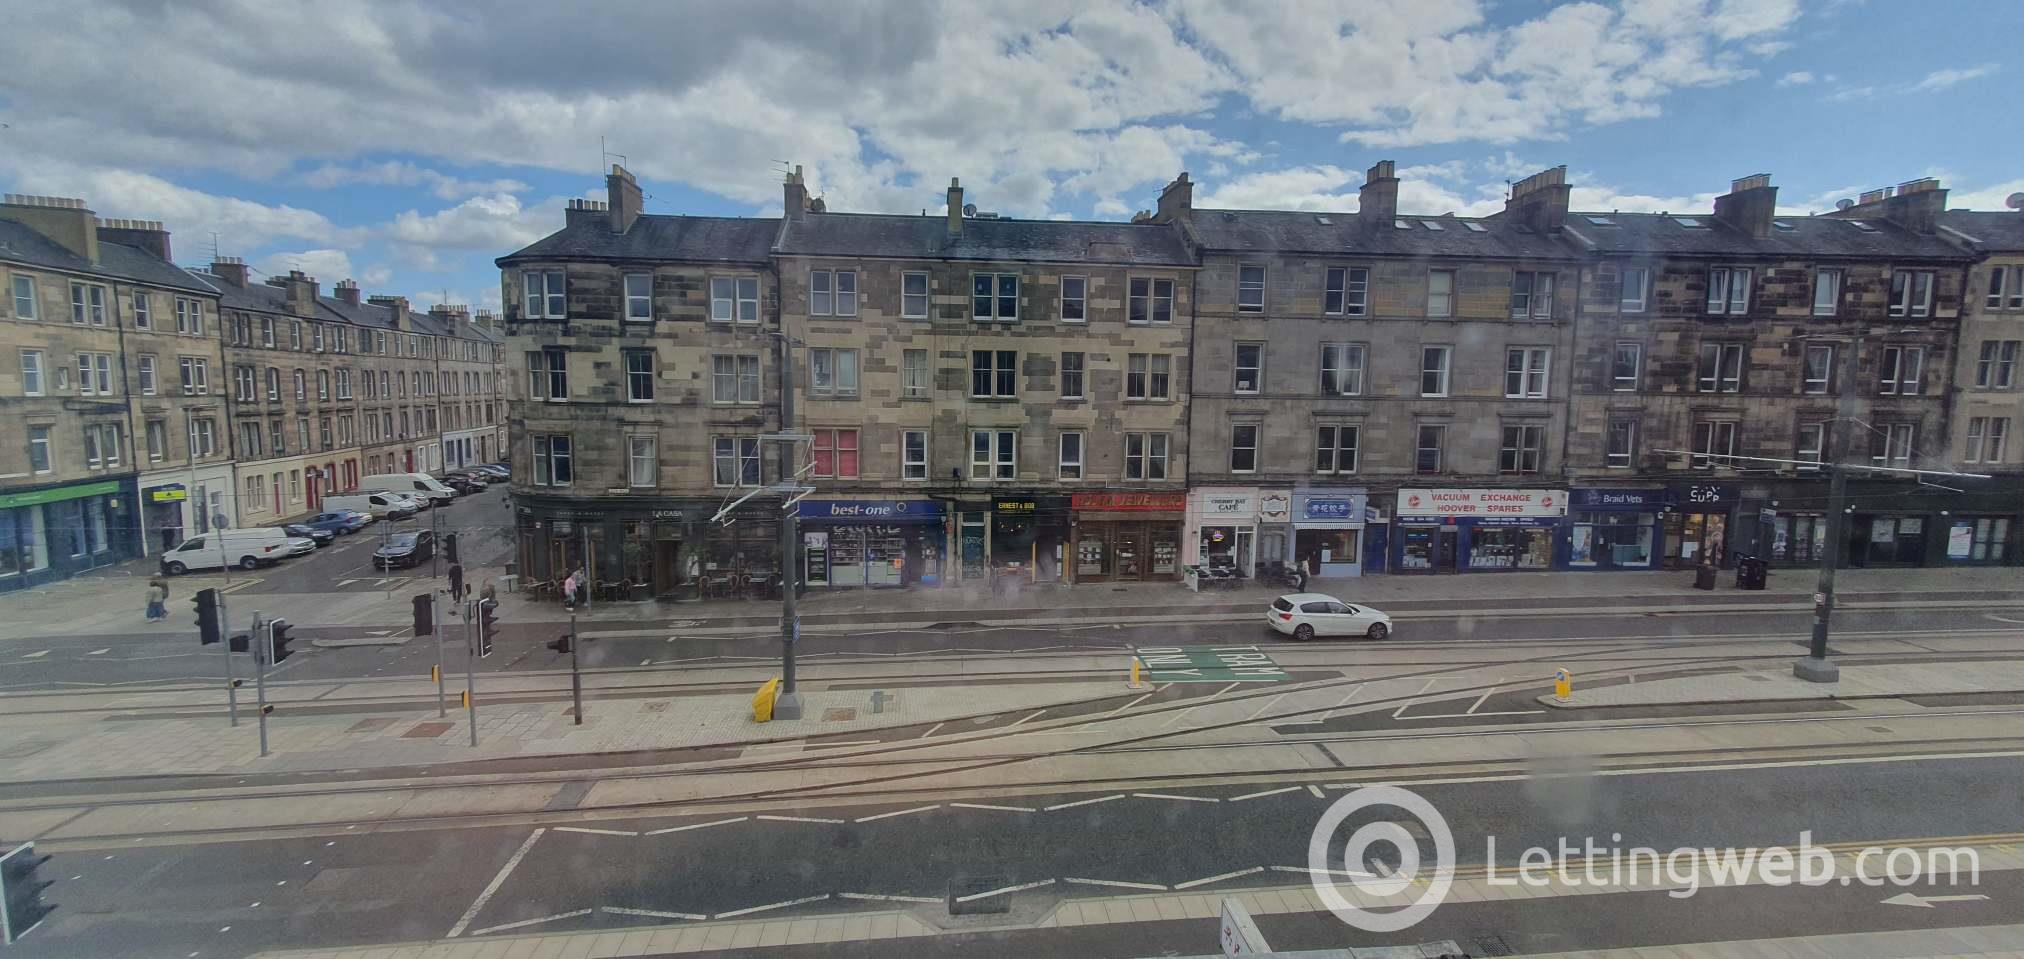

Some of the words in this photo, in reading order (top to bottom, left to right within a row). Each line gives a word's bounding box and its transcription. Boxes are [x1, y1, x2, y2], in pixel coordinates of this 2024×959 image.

[1603, 494, 1625, 503] Braid
[1626, 495, 1643, 503] Vets
[831, 503, 890, 515] best-one
[1137, 647, 1203, 676] ONLY
[1210, 645, 1286, 676] TRAM
